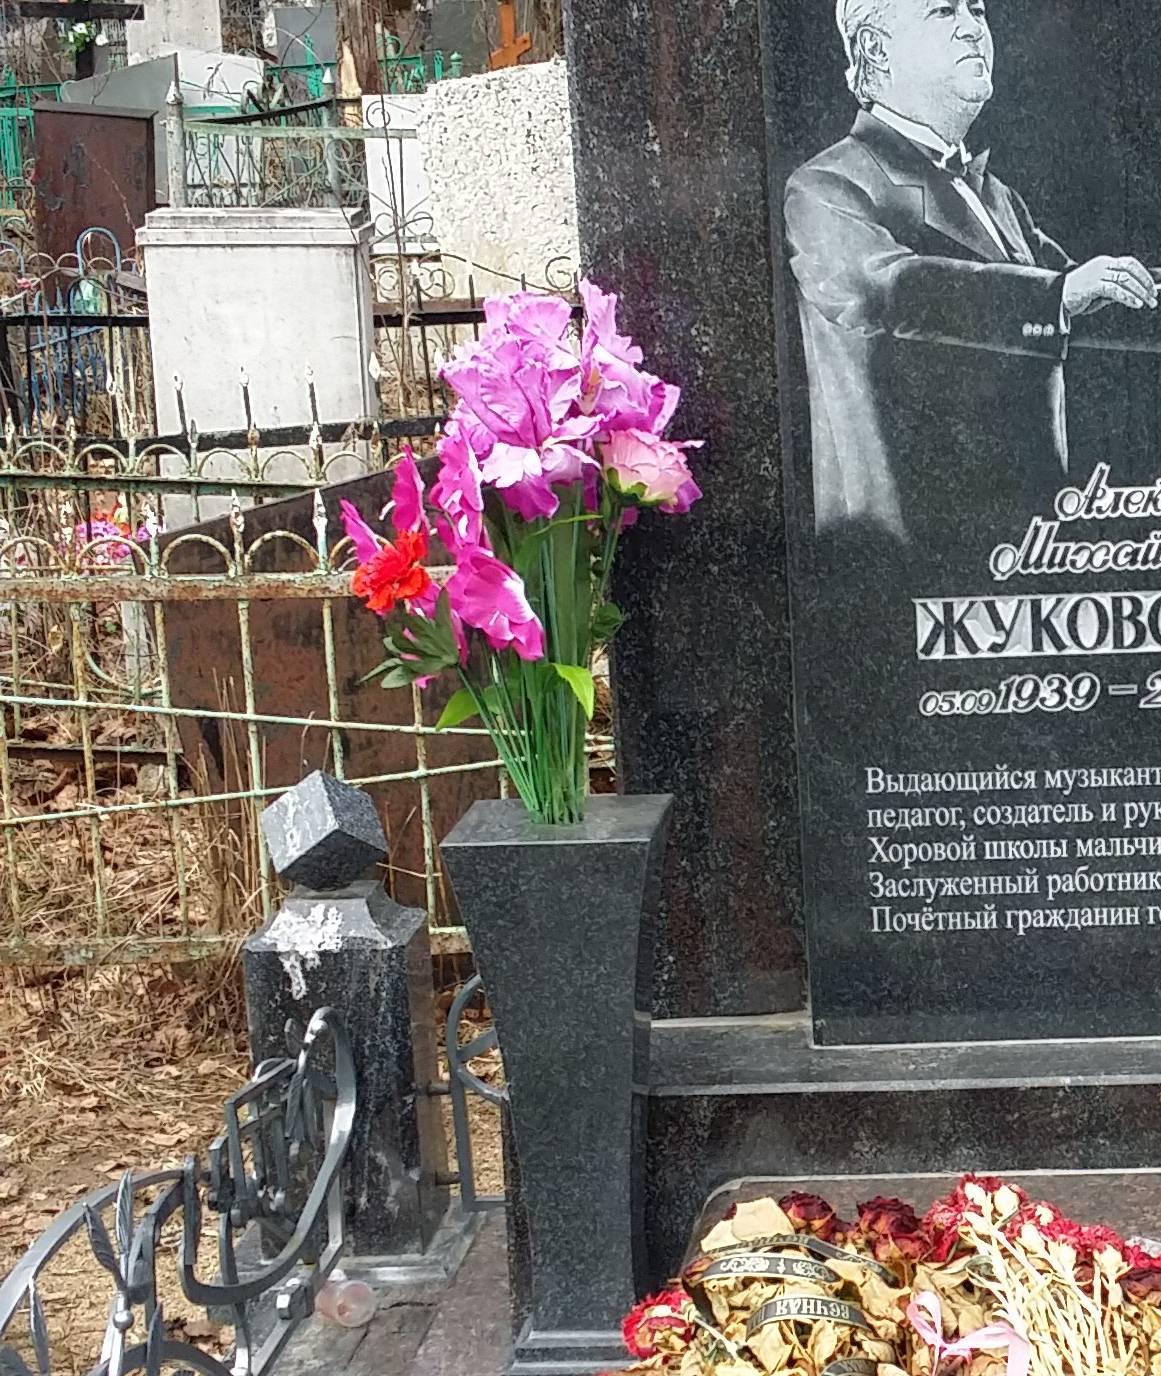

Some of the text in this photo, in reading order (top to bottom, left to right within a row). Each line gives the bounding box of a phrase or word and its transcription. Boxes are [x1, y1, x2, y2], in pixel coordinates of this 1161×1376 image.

[865, 763, 1036, 795] Выдающийся
[867, 804, 966, 832] педагог,
[973, 801, 1093, 825] создатель
[1102, 803, 1117, 821] и
[867, 835, 977, 868] Хоровой
[984, 837, 1069, 860] школы
[869, 867, 1040, 903] Заслуженный
[1046, 865, 1161, 899] работник
[871, 903, 998, 932] Почётный
[1006, 907, 1140, 935] гражданин
